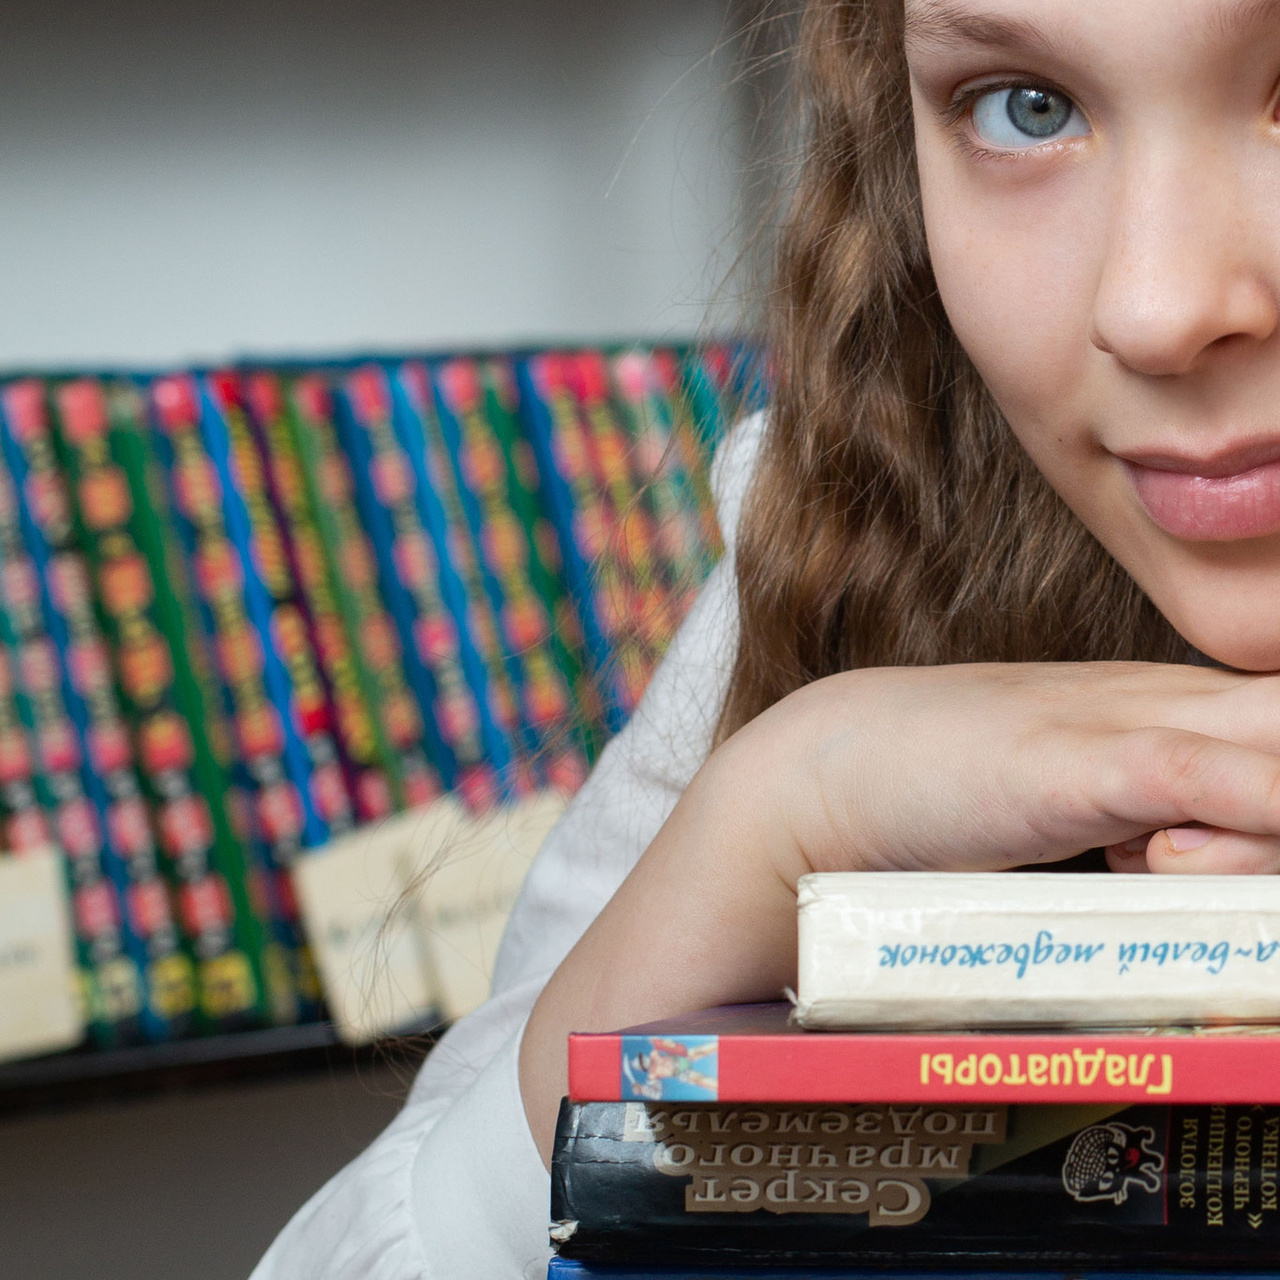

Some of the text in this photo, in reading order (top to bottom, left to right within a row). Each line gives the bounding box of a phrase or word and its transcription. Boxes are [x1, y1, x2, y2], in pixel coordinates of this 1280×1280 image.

[879, 930, 1105, 980] медвежонок
[919, 1048, 1173, 1094] Гладиаторы
[666, 1135, 960, 1170] мрачного
[1178, 1118, 1199, 1209] ЗОЛОТАЯ
[694, 1168, 922, 1217] Секрет
